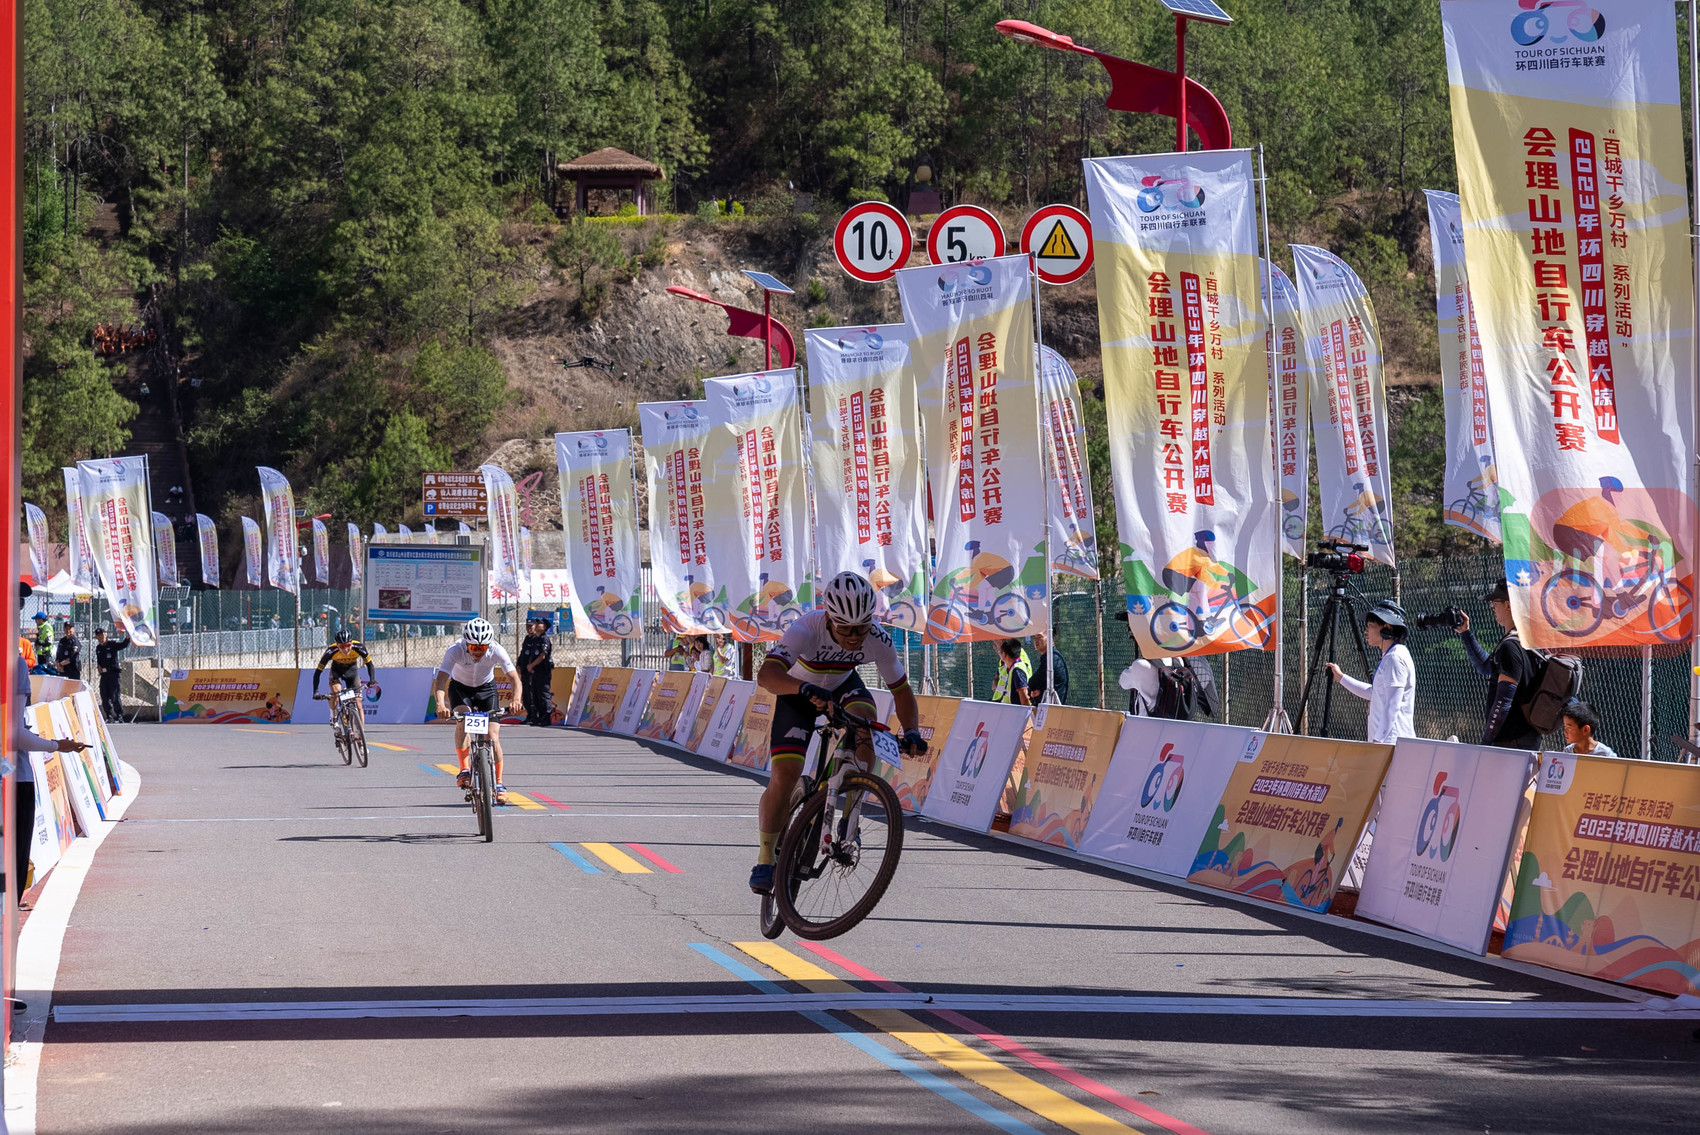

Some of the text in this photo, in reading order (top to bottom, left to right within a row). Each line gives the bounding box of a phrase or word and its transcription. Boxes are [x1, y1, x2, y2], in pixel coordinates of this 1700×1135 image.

[1515, 45, 1605, 58] TOUR OF SICHUAN
[1515, 55, 1606, 71] 环四川自行车联赛
[1140, 218, 1206, 231] 环四川自行车联赛
[1172, 211, 1206, 219] SICHUAN
[852, 220, 888, 261] 10
[946, 226, 968, 263] 5
[1523, 127, 1588, 453] 会理山地自行车公开赛
[1575, 138, 1617, 431] 2023年环四川穿越大凉山
[1147, 271, 1188, 514] 会理山地自行车公开赛
[466, 718, 487, 728] 251
[874, 732, 899, 758] 233
[1235, 799, 1331, 838] 会理山地自行车公开赛
[1561, 846, 1700, 901] 会理山地自行车公
